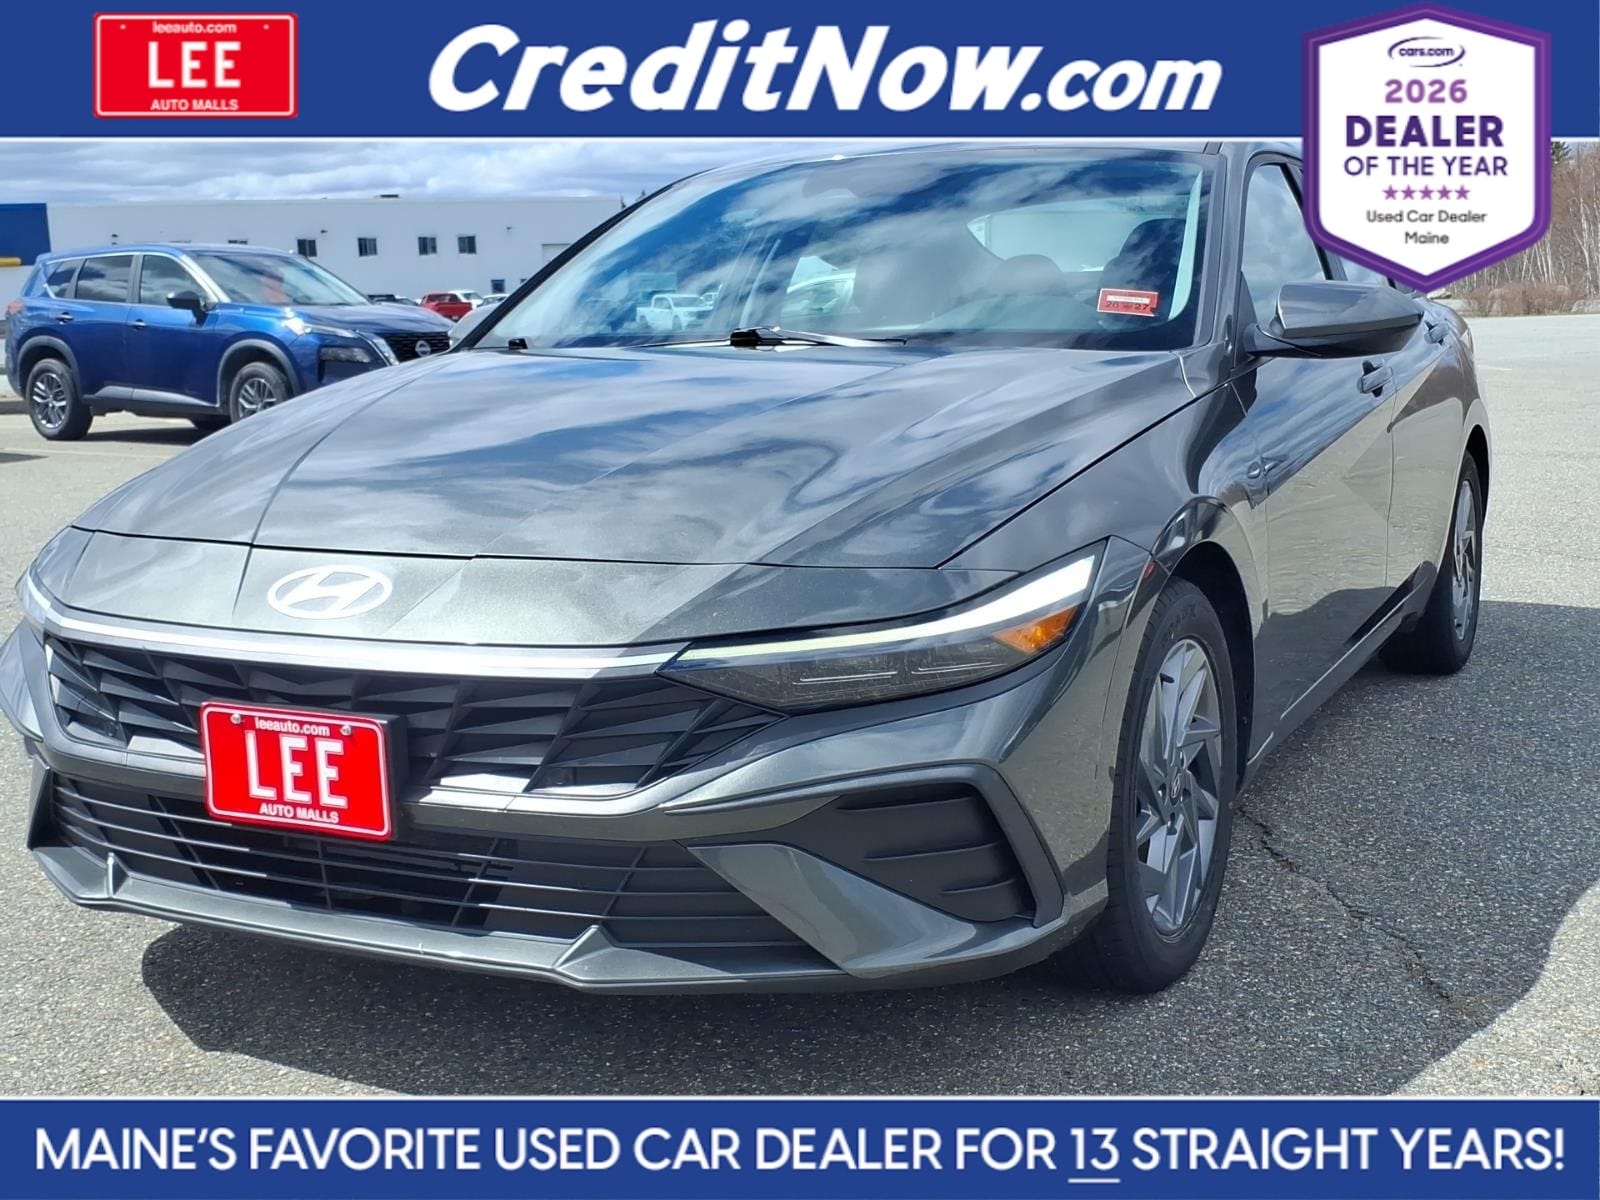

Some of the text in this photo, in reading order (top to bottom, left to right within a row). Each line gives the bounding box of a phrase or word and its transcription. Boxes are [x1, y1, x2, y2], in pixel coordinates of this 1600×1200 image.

[254, 716, 330, 737] leeauto.com
[245, 729, 348, 809] LEE
[259, 802, 339, 824] AUTO MALLS
